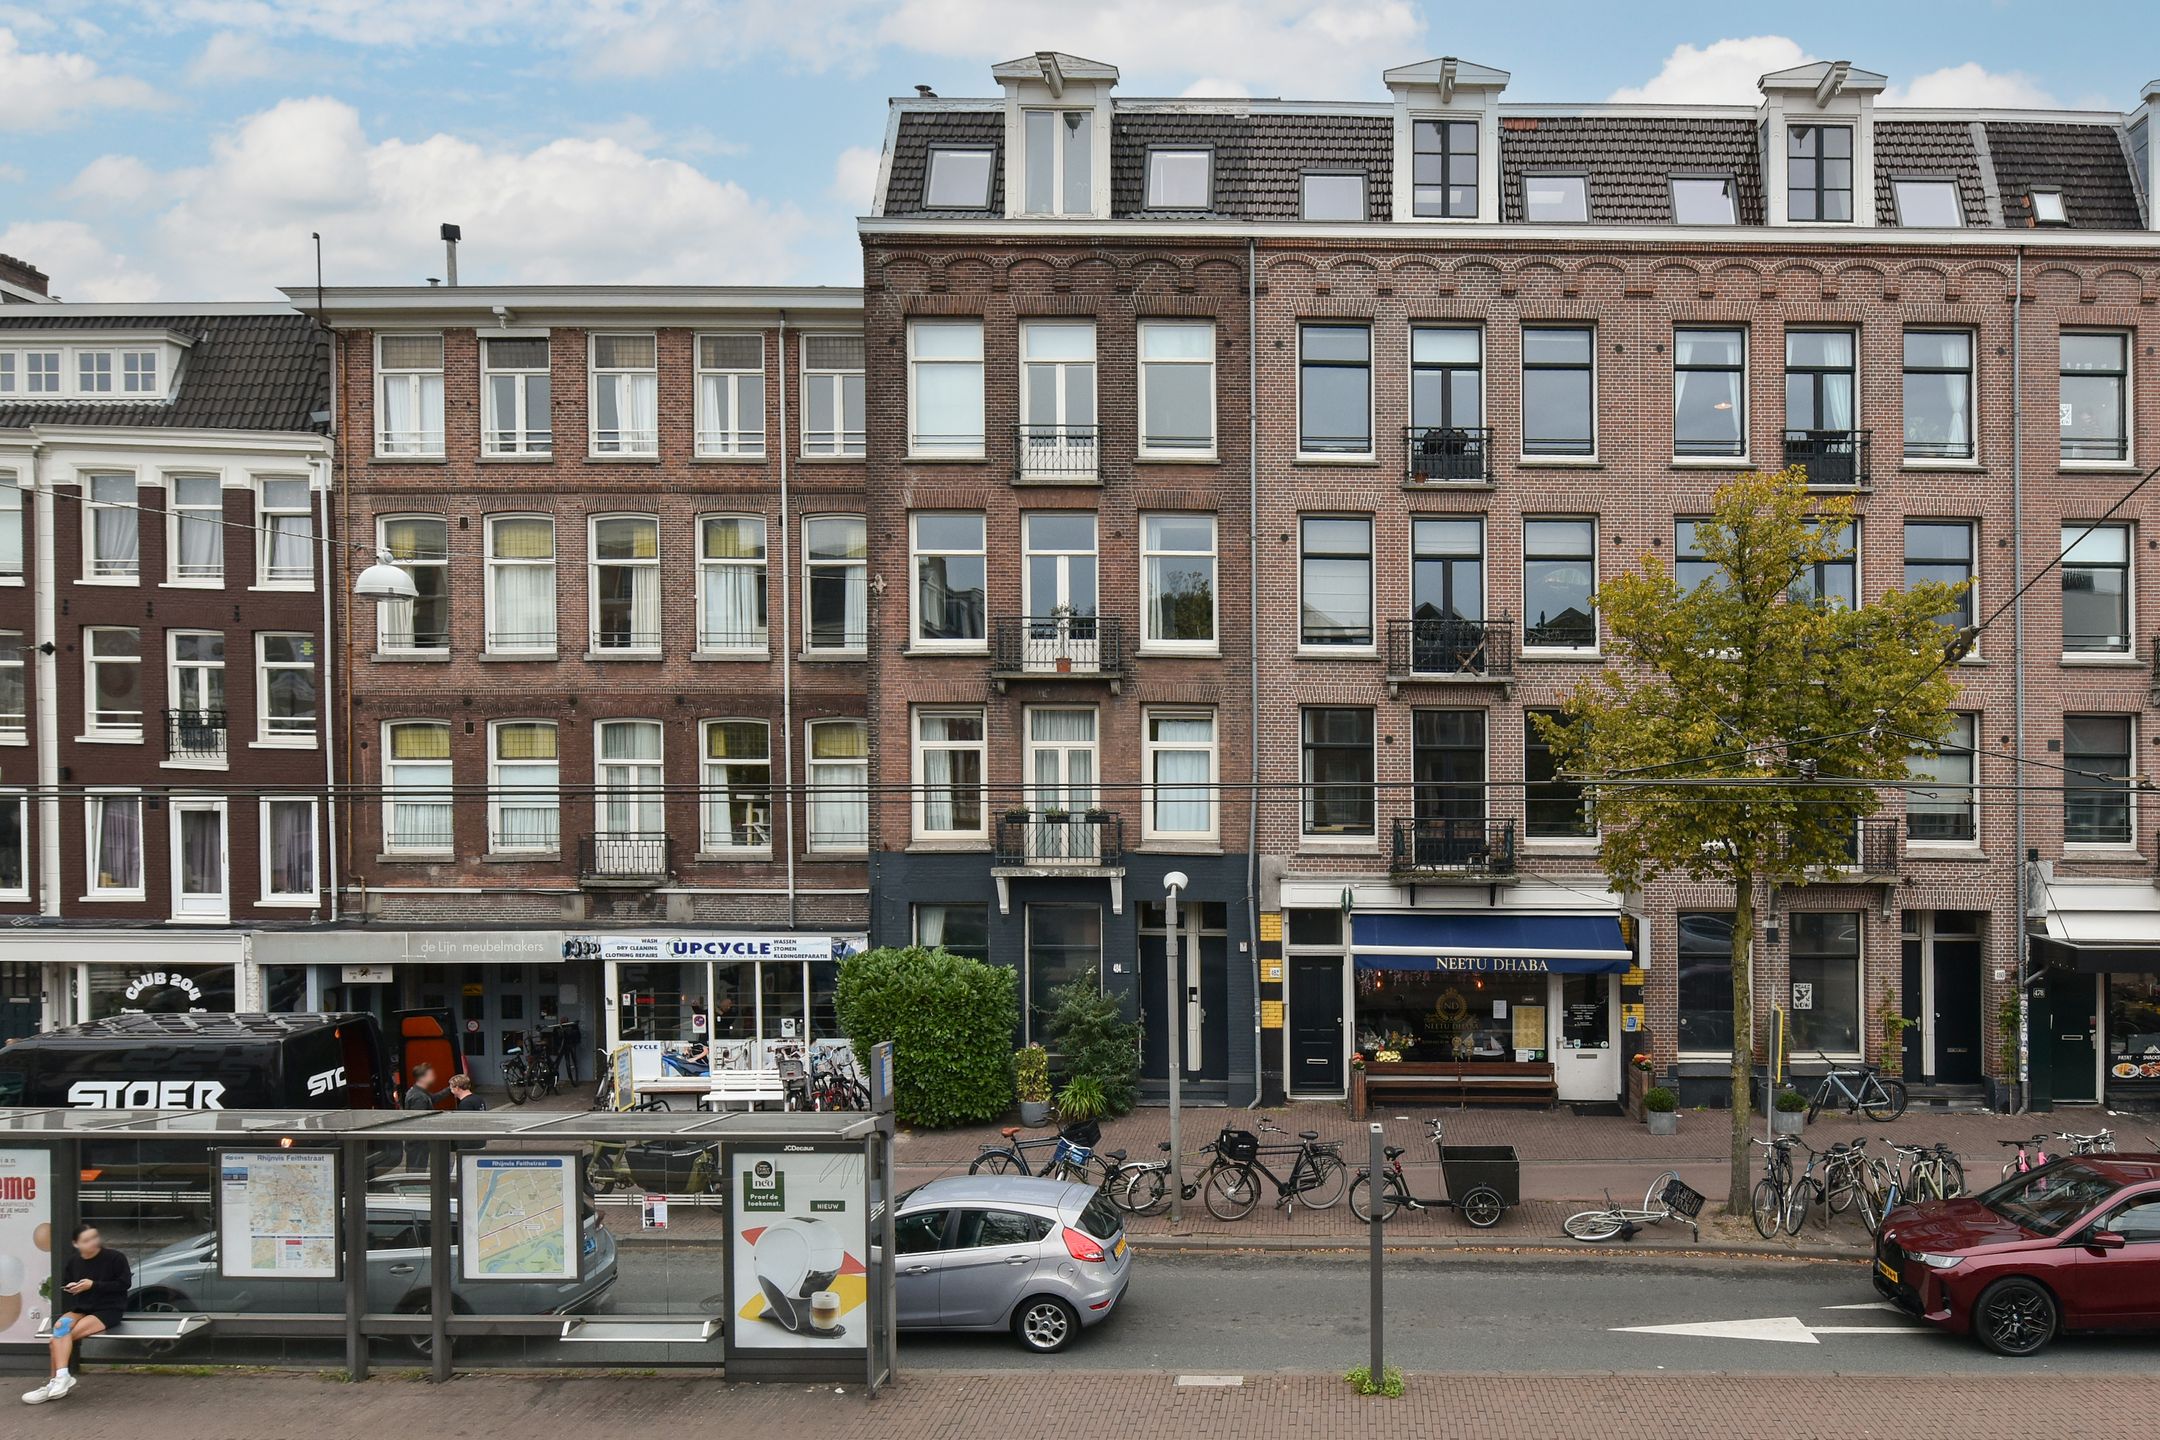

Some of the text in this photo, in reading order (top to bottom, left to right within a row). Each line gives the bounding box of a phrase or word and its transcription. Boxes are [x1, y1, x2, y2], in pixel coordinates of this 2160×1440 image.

[421, 939, 544, 955] de Lijn meubelmakers
[673, 942, 771, 955] UPCYCLE
[1436, 957, 1549, 971] NEETU DHABA
[125, 972, 167, 1001] CLUB
[67, 1080, 226, 1109] STOER
[286, 1154, 325, 1162] Feithstraat
[30, 1311, 41, 1320] 30
